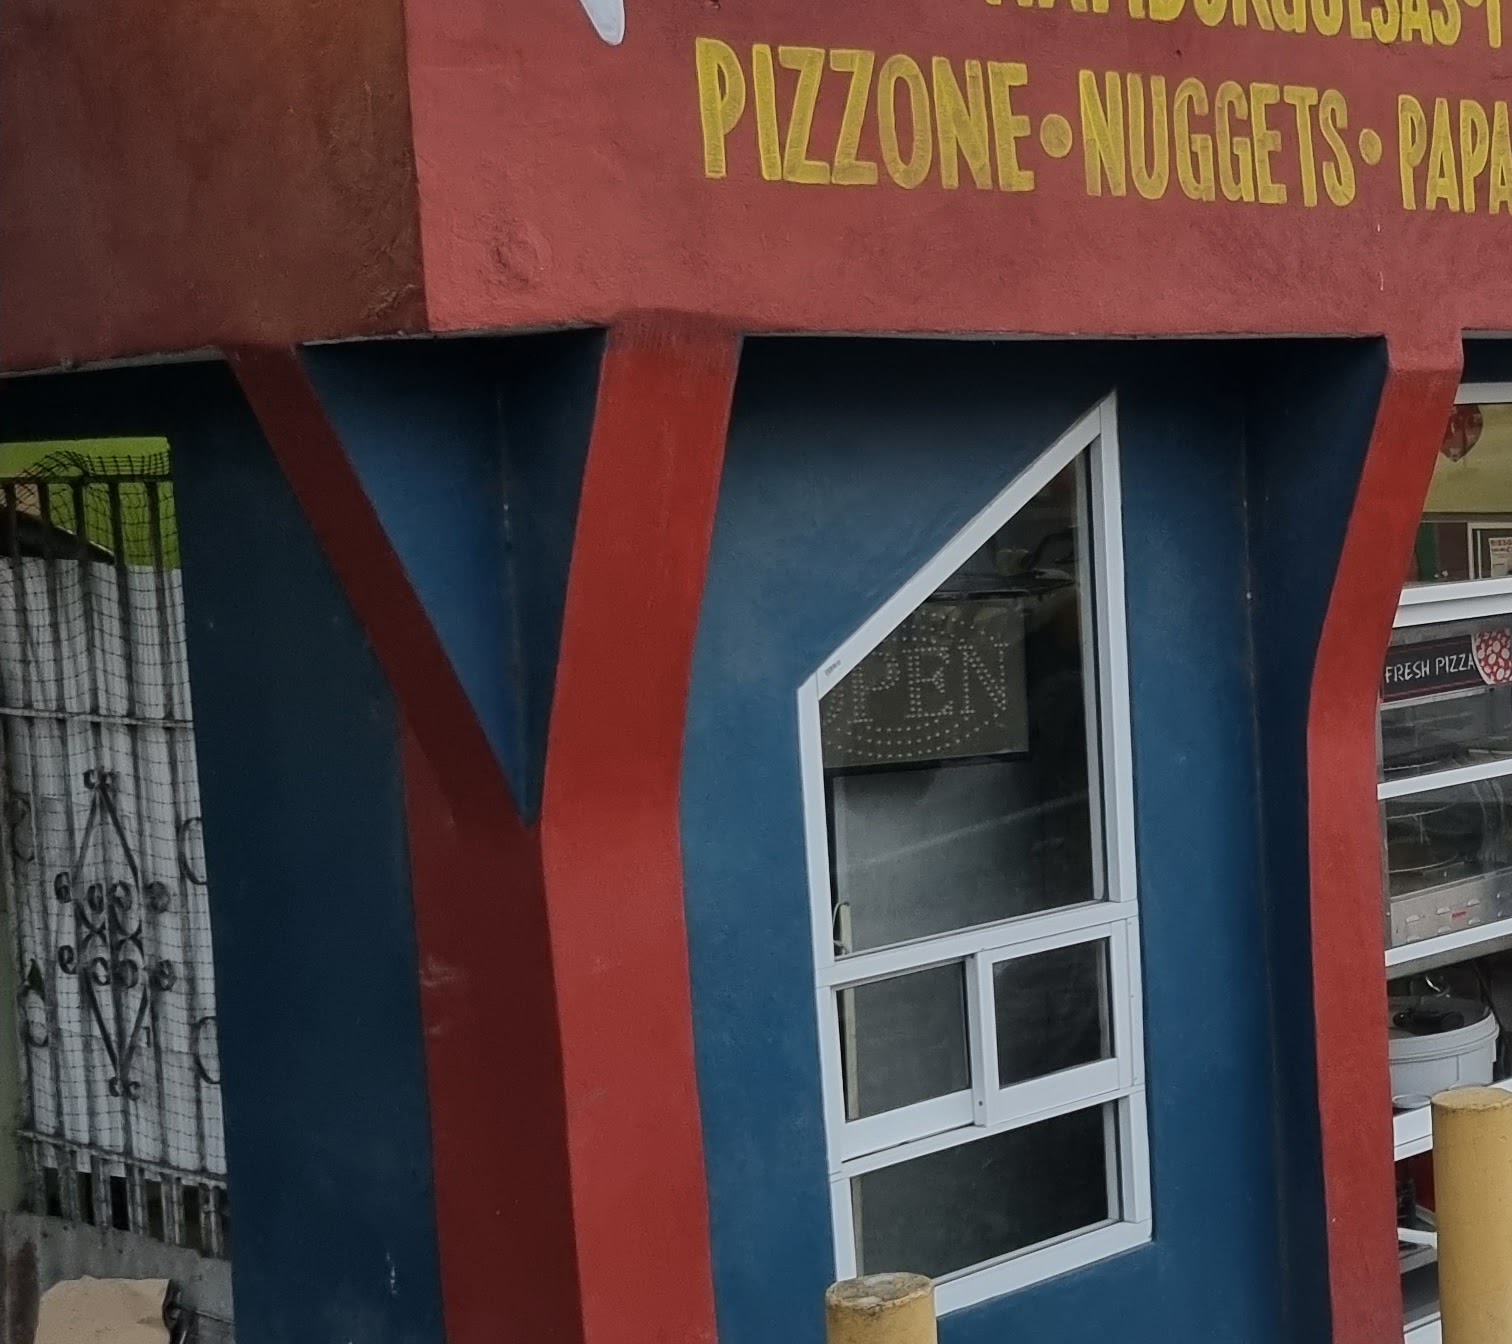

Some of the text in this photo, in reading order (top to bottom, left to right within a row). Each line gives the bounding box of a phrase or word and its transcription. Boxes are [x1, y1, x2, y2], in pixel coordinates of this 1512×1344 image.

[695, 37, 1036, 192] PIZZONE
[1078, 69, 1357, 207] NUGGETS
[1384, 652, 1476, 684] FRESH PIZZA
